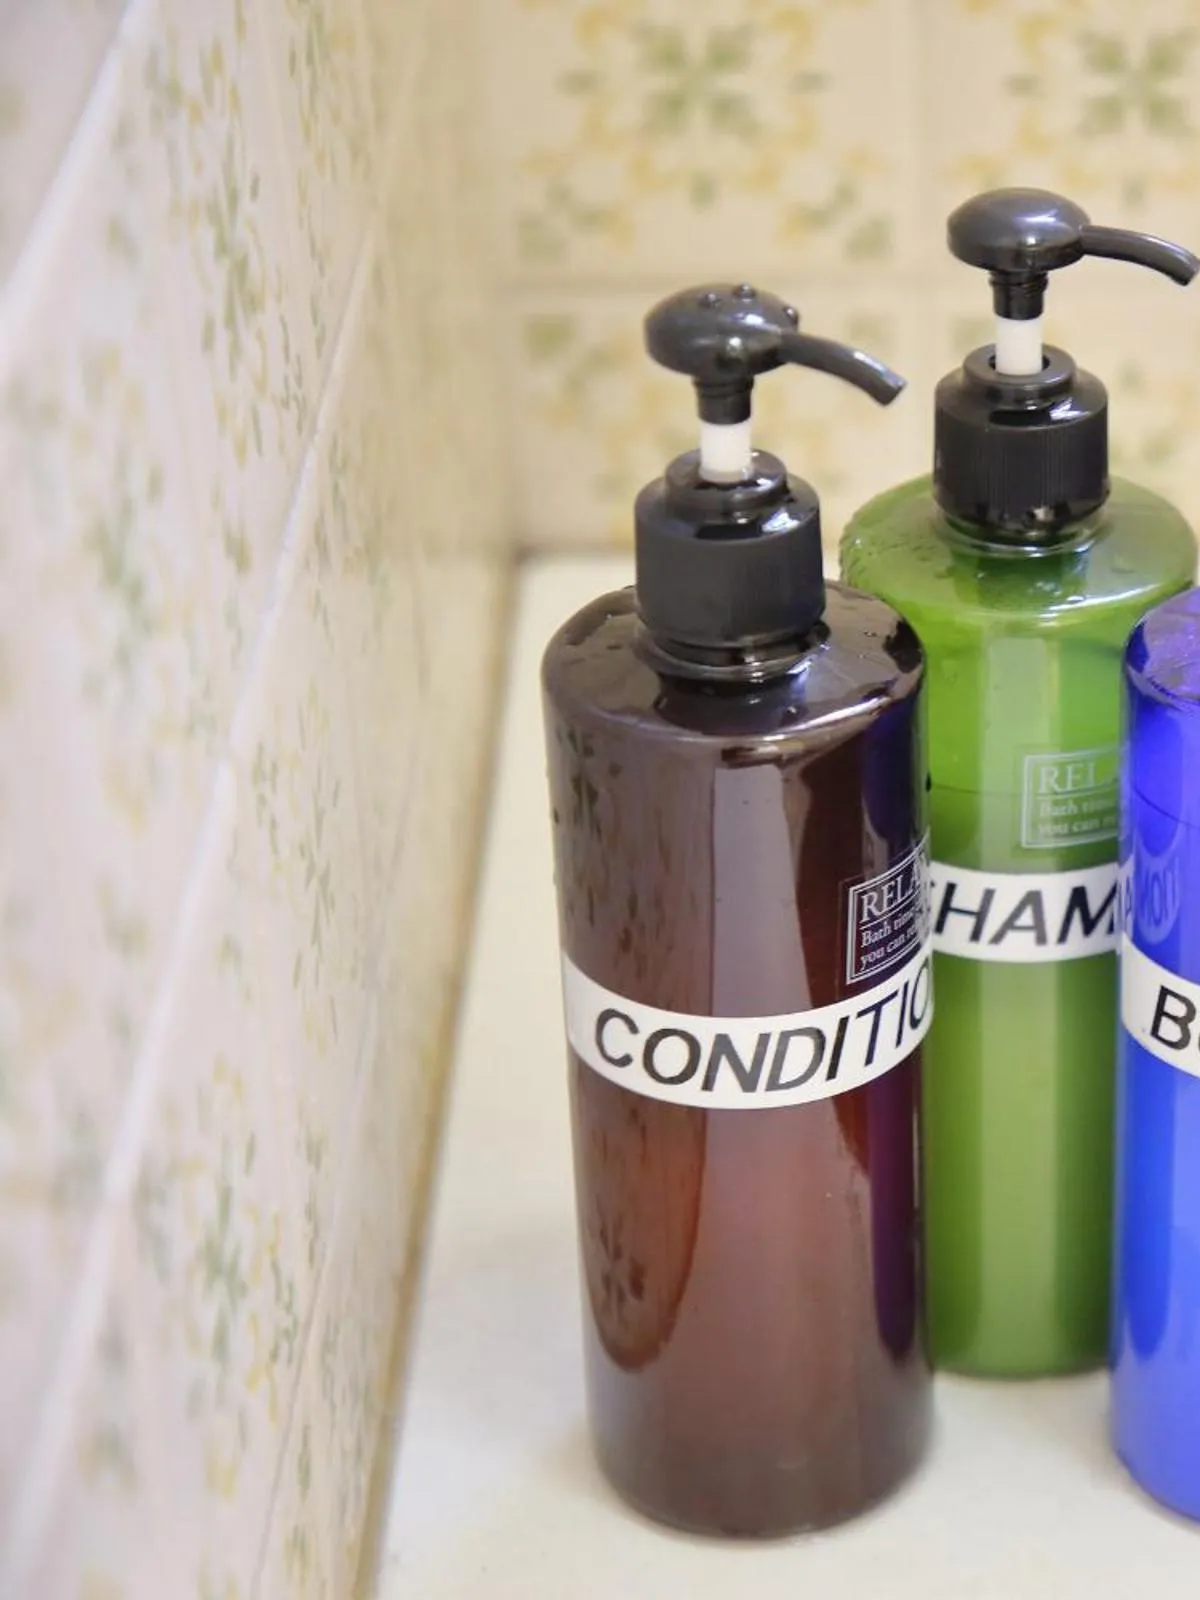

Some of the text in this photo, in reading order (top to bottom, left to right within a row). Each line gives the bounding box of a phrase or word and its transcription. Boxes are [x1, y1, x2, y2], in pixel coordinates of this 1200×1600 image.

[930, 881, 1117, 946] HAM
[860, 933, 906, 971] you can
[861, 921, 891, 948] Bath
